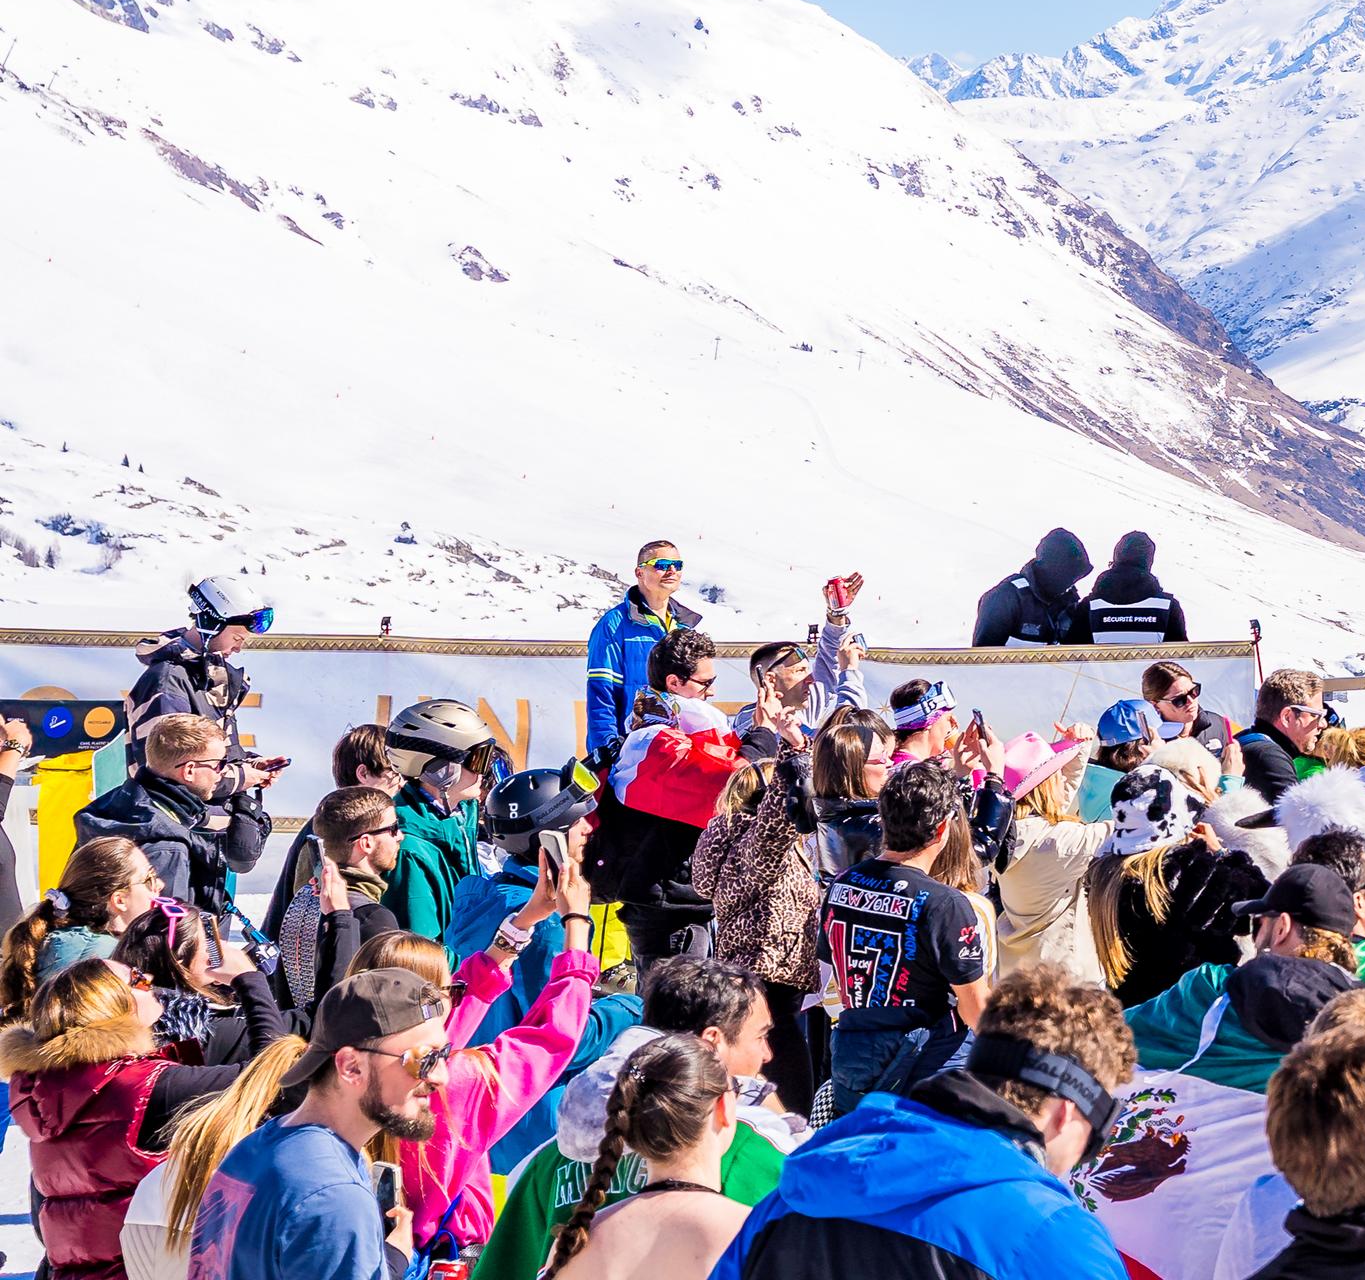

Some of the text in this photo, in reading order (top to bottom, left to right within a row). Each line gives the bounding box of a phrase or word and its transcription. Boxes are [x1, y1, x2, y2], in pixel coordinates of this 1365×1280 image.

[1103, 615, 1157, 623] SÉCURITÉ PRIVÉE
[849, 871, 892, 890] TENNIS
[830, 883, 907, 915] NEW YORK
[828, 919, 902, 1009] 17
